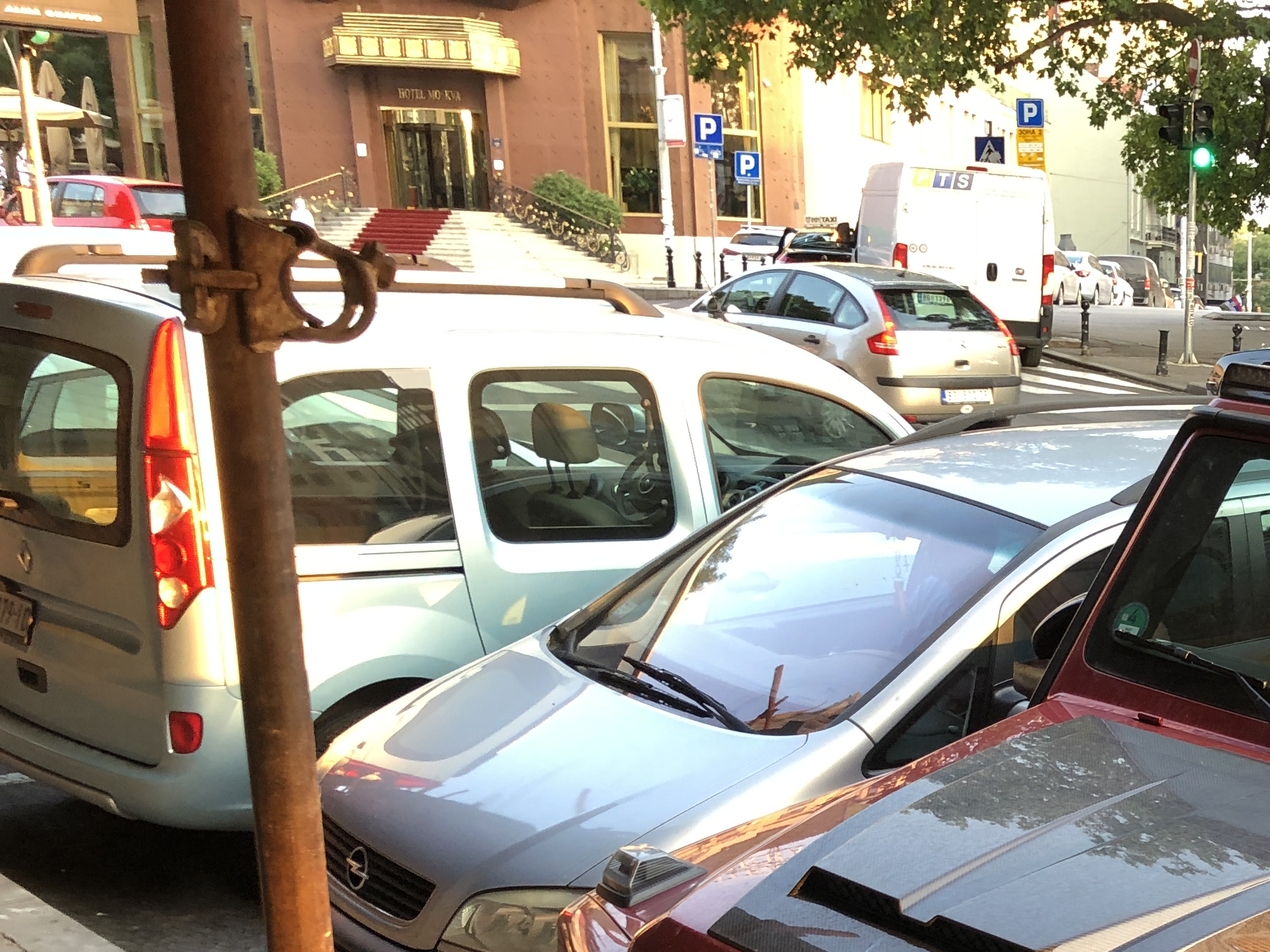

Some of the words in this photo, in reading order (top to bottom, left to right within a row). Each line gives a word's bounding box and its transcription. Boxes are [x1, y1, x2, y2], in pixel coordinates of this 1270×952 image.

[397, 87, 426, 100] HOTEL
[1023, 102, 1038, 123] P
[699, 116, 718, 141] P
[740, 154, 756, 176] P
